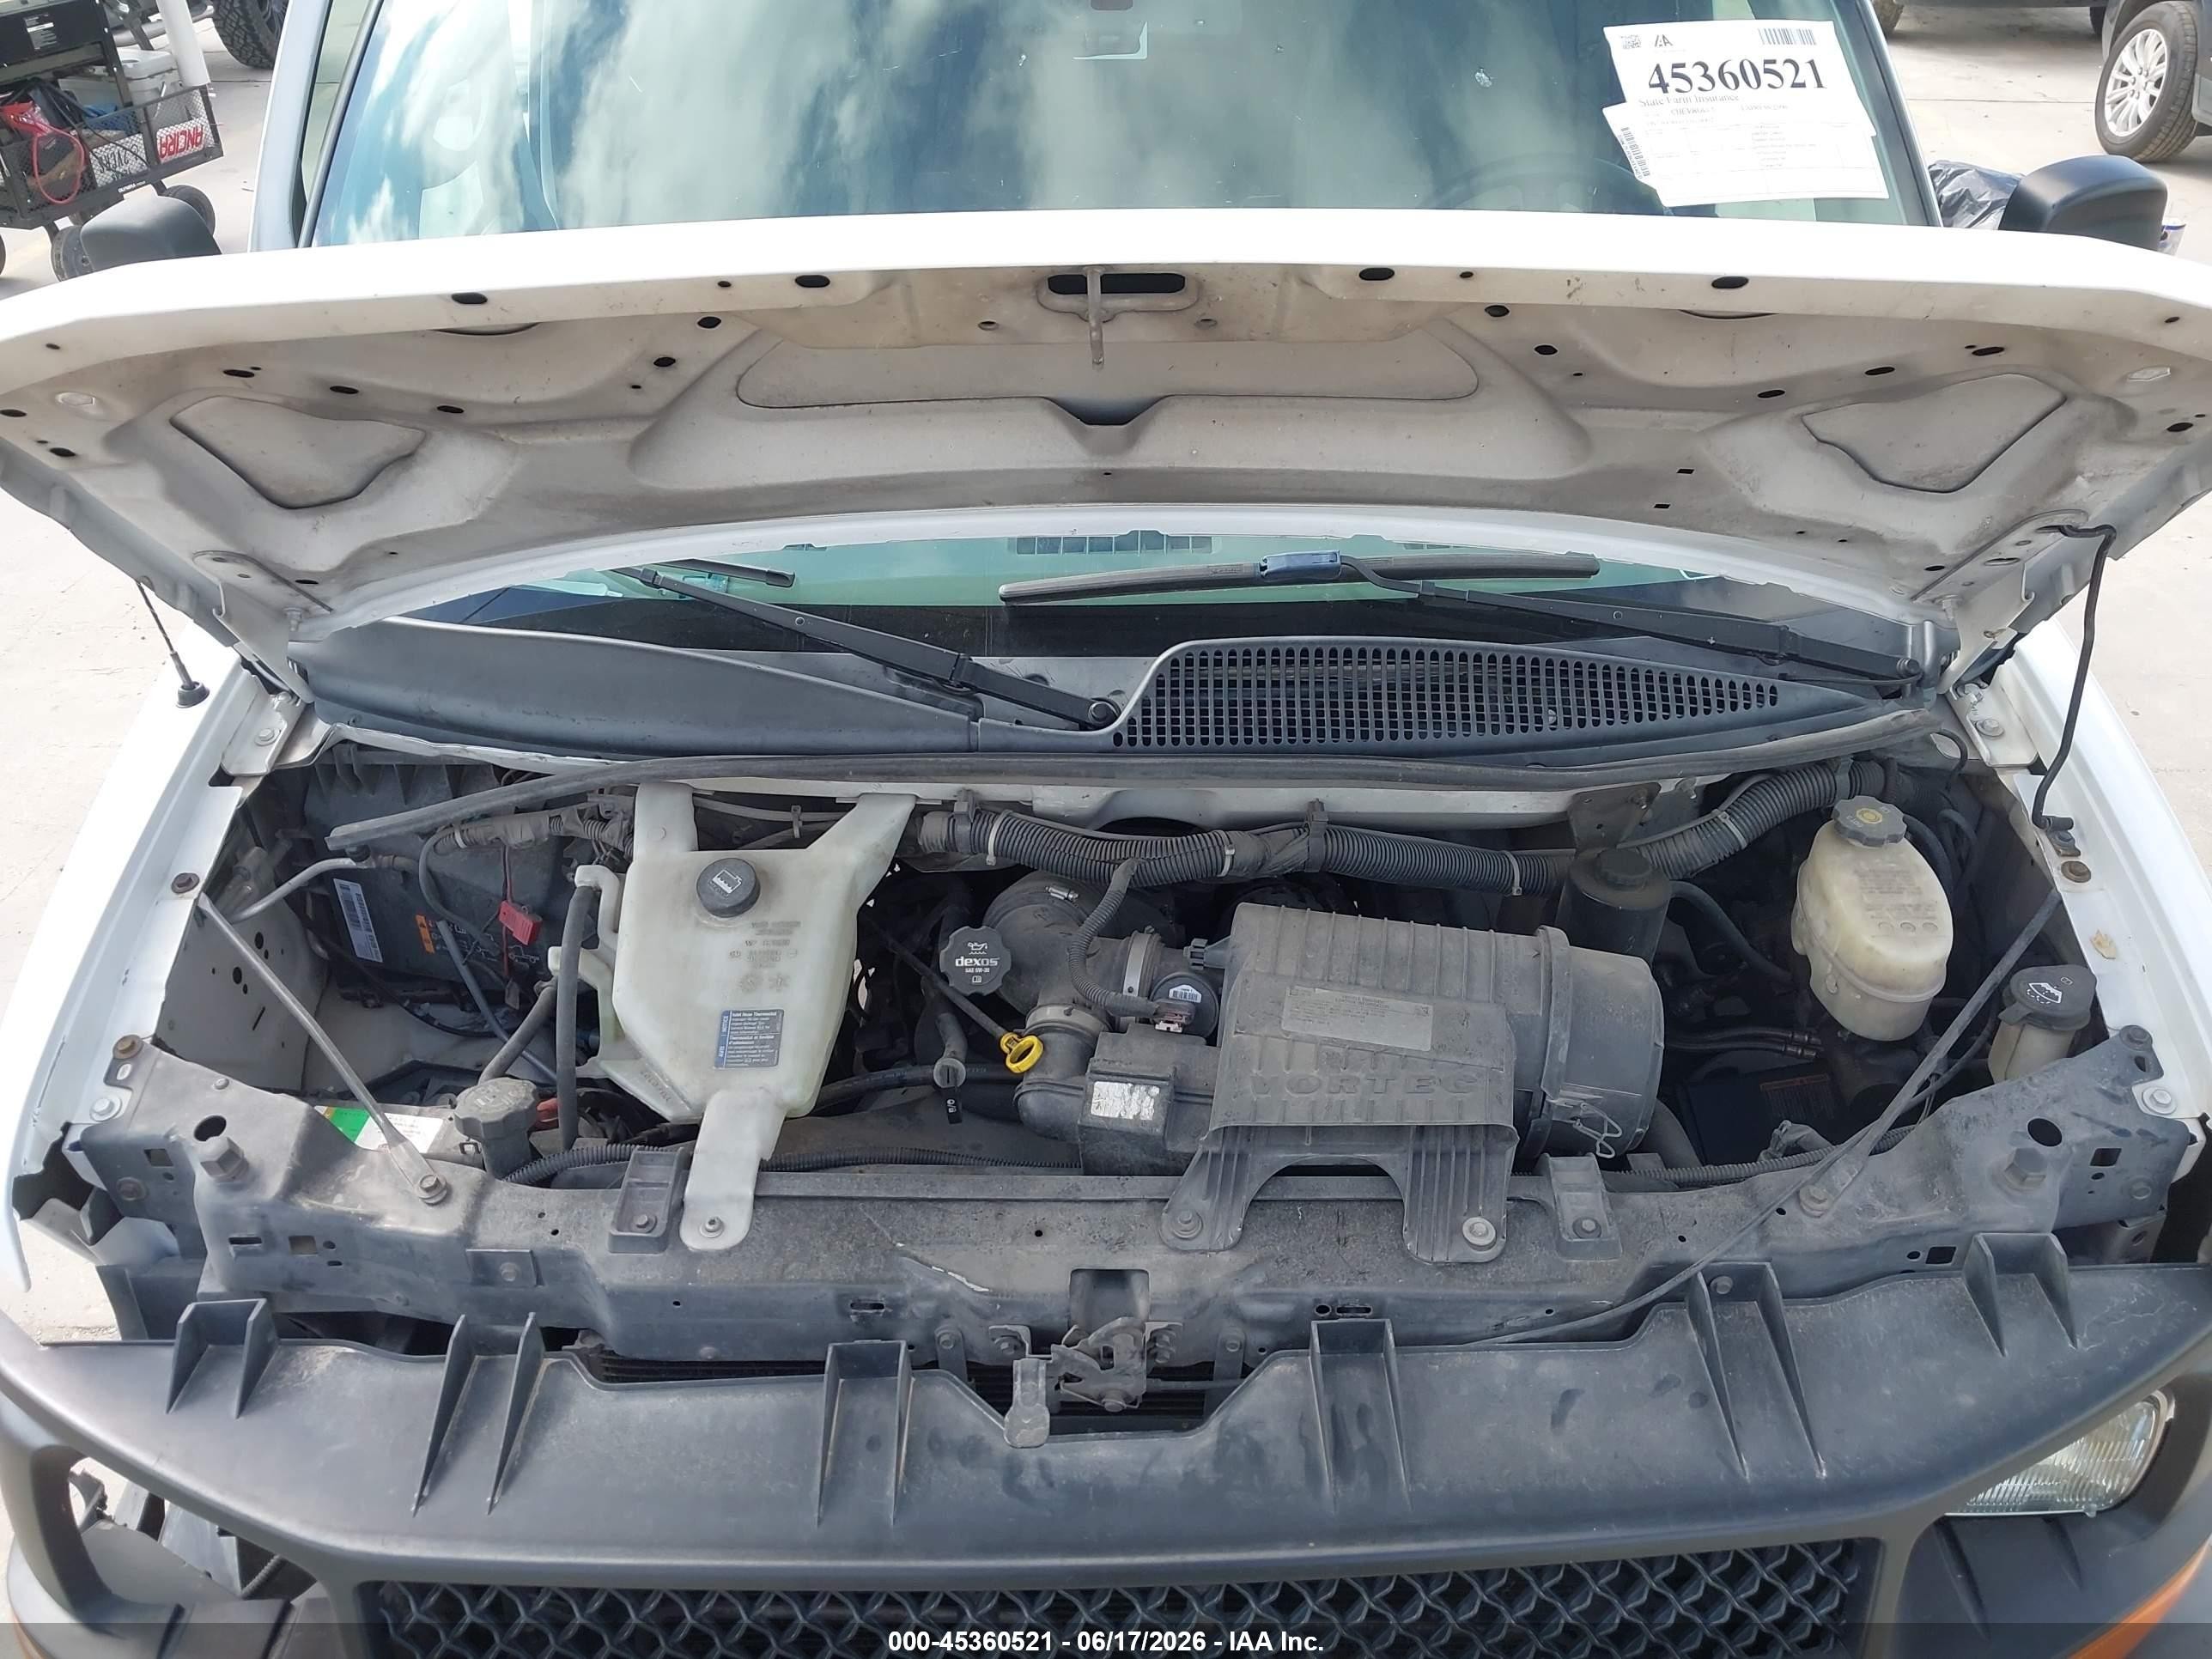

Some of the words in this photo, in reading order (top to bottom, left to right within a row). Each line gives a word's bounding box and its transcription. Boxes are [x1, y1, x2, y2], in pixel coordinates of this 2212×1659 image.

[1648, 58, 1827, 94] 45360521
[1638, 95, 1664, 108] State
[1666, 94, 1692, 105] Farm
[1694, 94, 1741, 104] Insurance
[955, 955, 1000, 967] dexos
[1250, 1075, 1479, 1096] VORTEC
